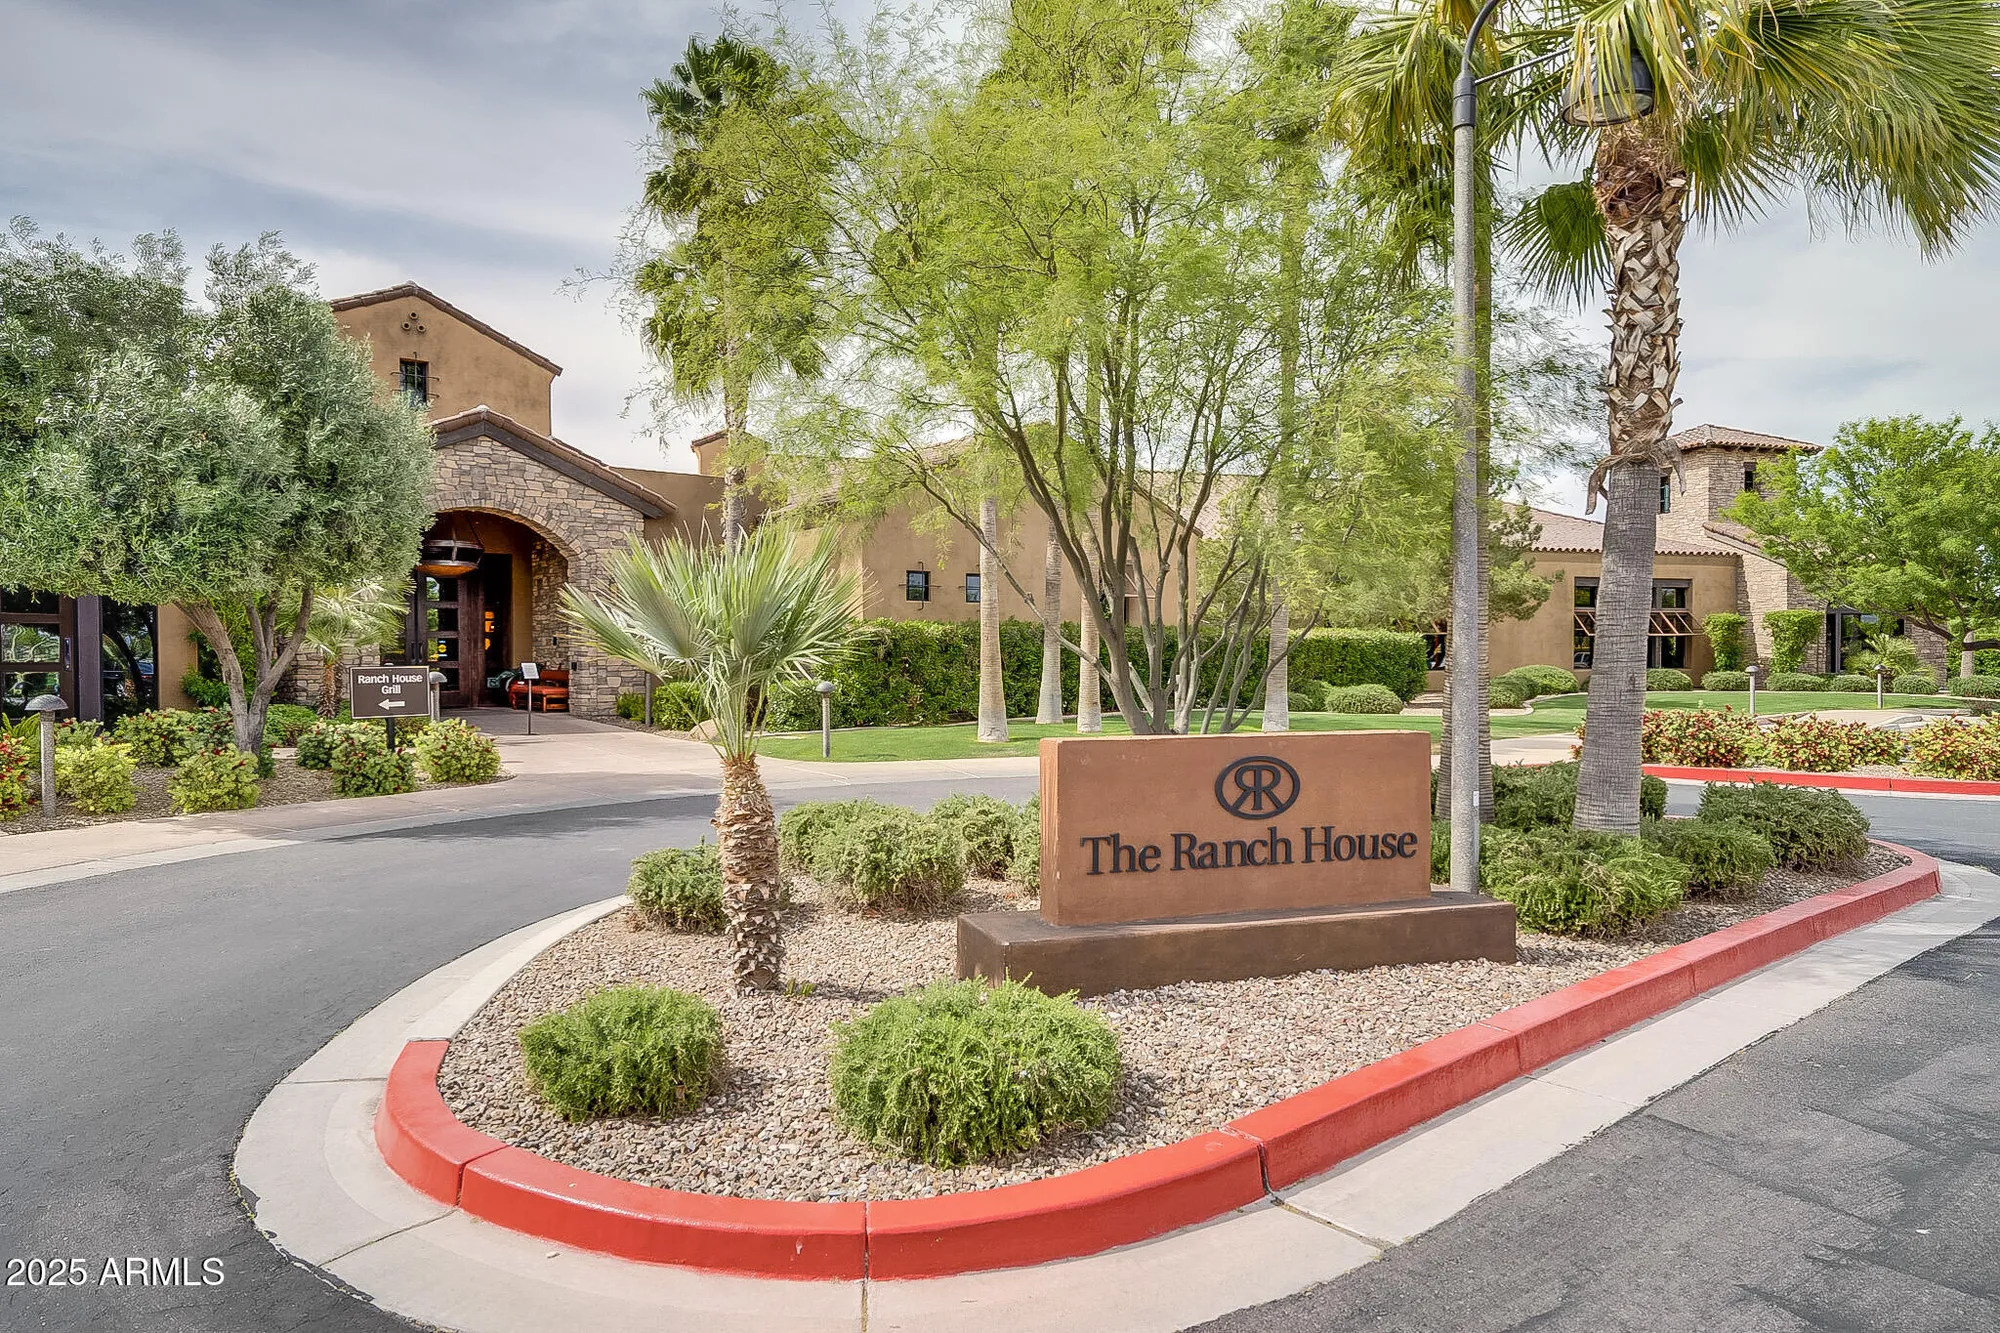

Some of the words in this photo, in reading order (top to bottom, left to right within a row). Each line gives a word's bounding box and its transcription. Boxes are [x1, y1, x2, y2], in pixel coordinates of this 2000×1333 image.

[357, 673, 390, 684] Ranch
[392, 674, 423, 683] House
[381, 684, 402, 694] Grill
[1080, 833, 1161, 876] The
[1170, 826, 1294, 871] Ranch
[1301, 825, 1418, 864] House
